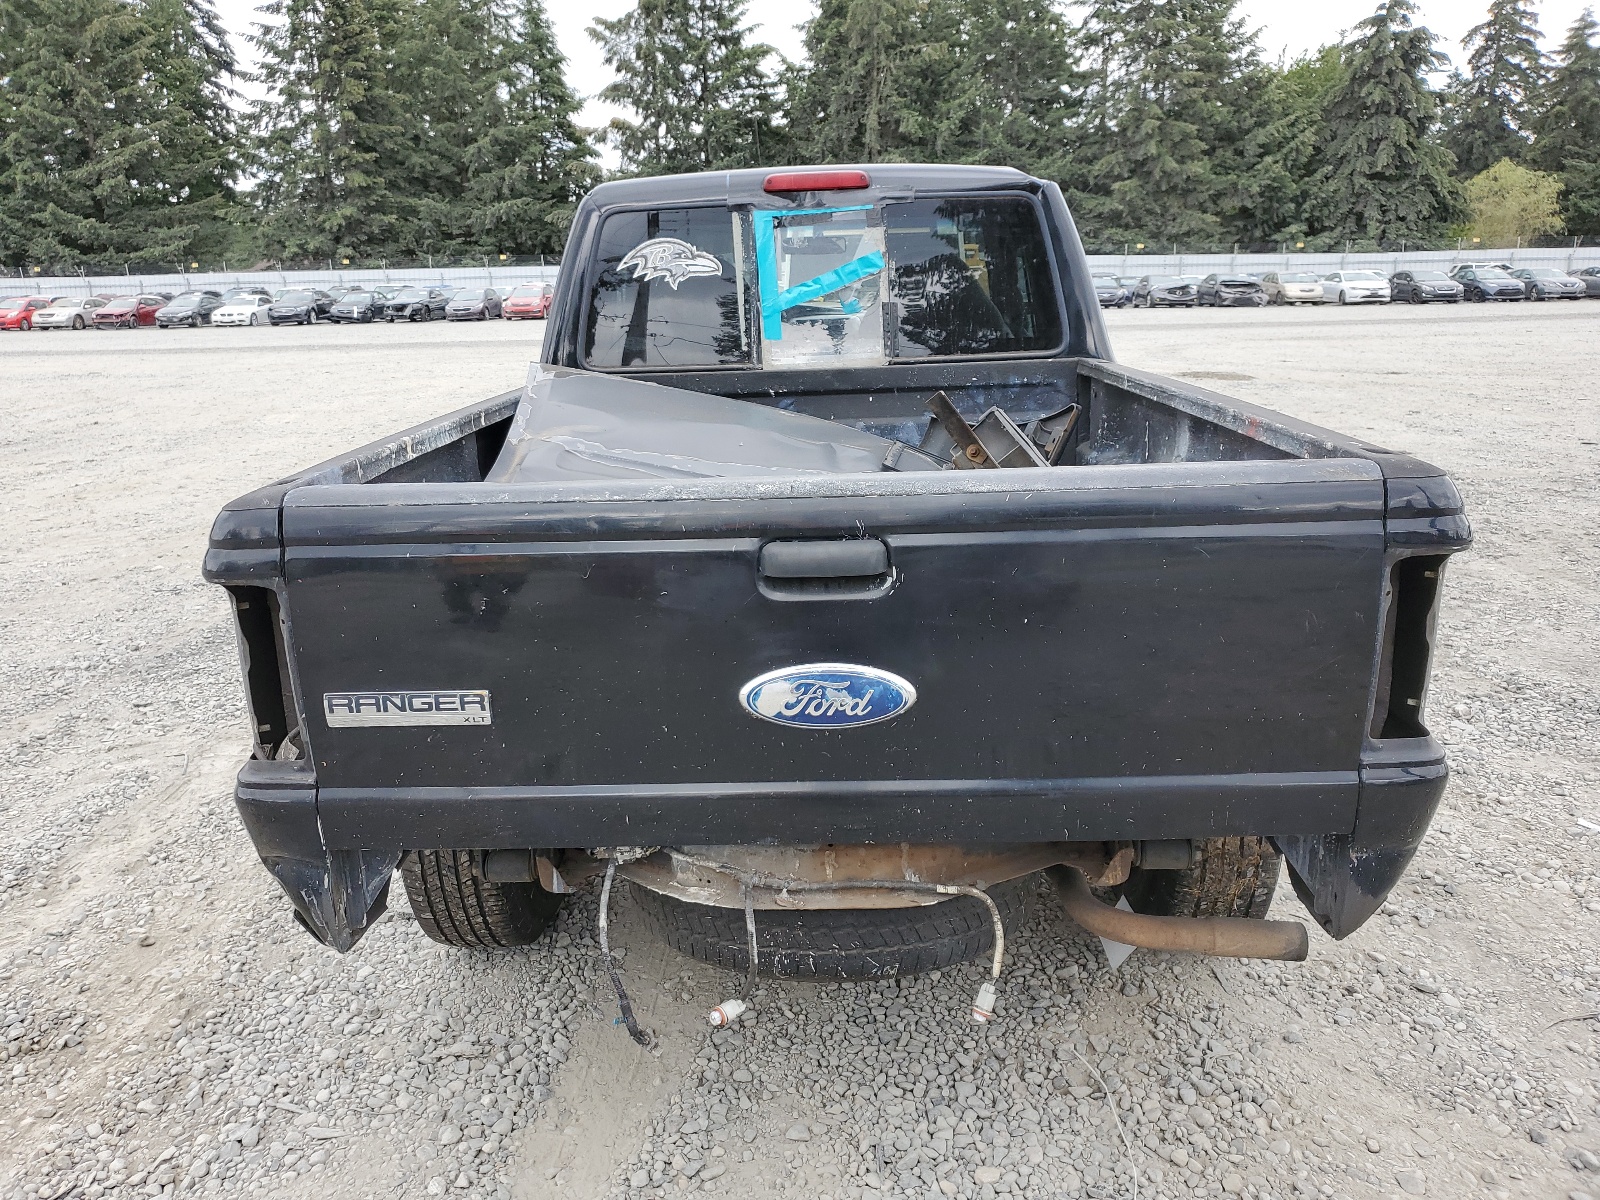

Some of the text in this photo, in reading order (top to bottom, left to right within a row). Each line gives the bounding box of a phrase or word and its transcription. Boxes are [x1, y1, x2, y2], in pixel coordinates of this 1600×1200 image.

[327, 693, 487, 713] RANGER
[780, 679, 875, 717] Ford
[462, 715, 488, 723] XLT
